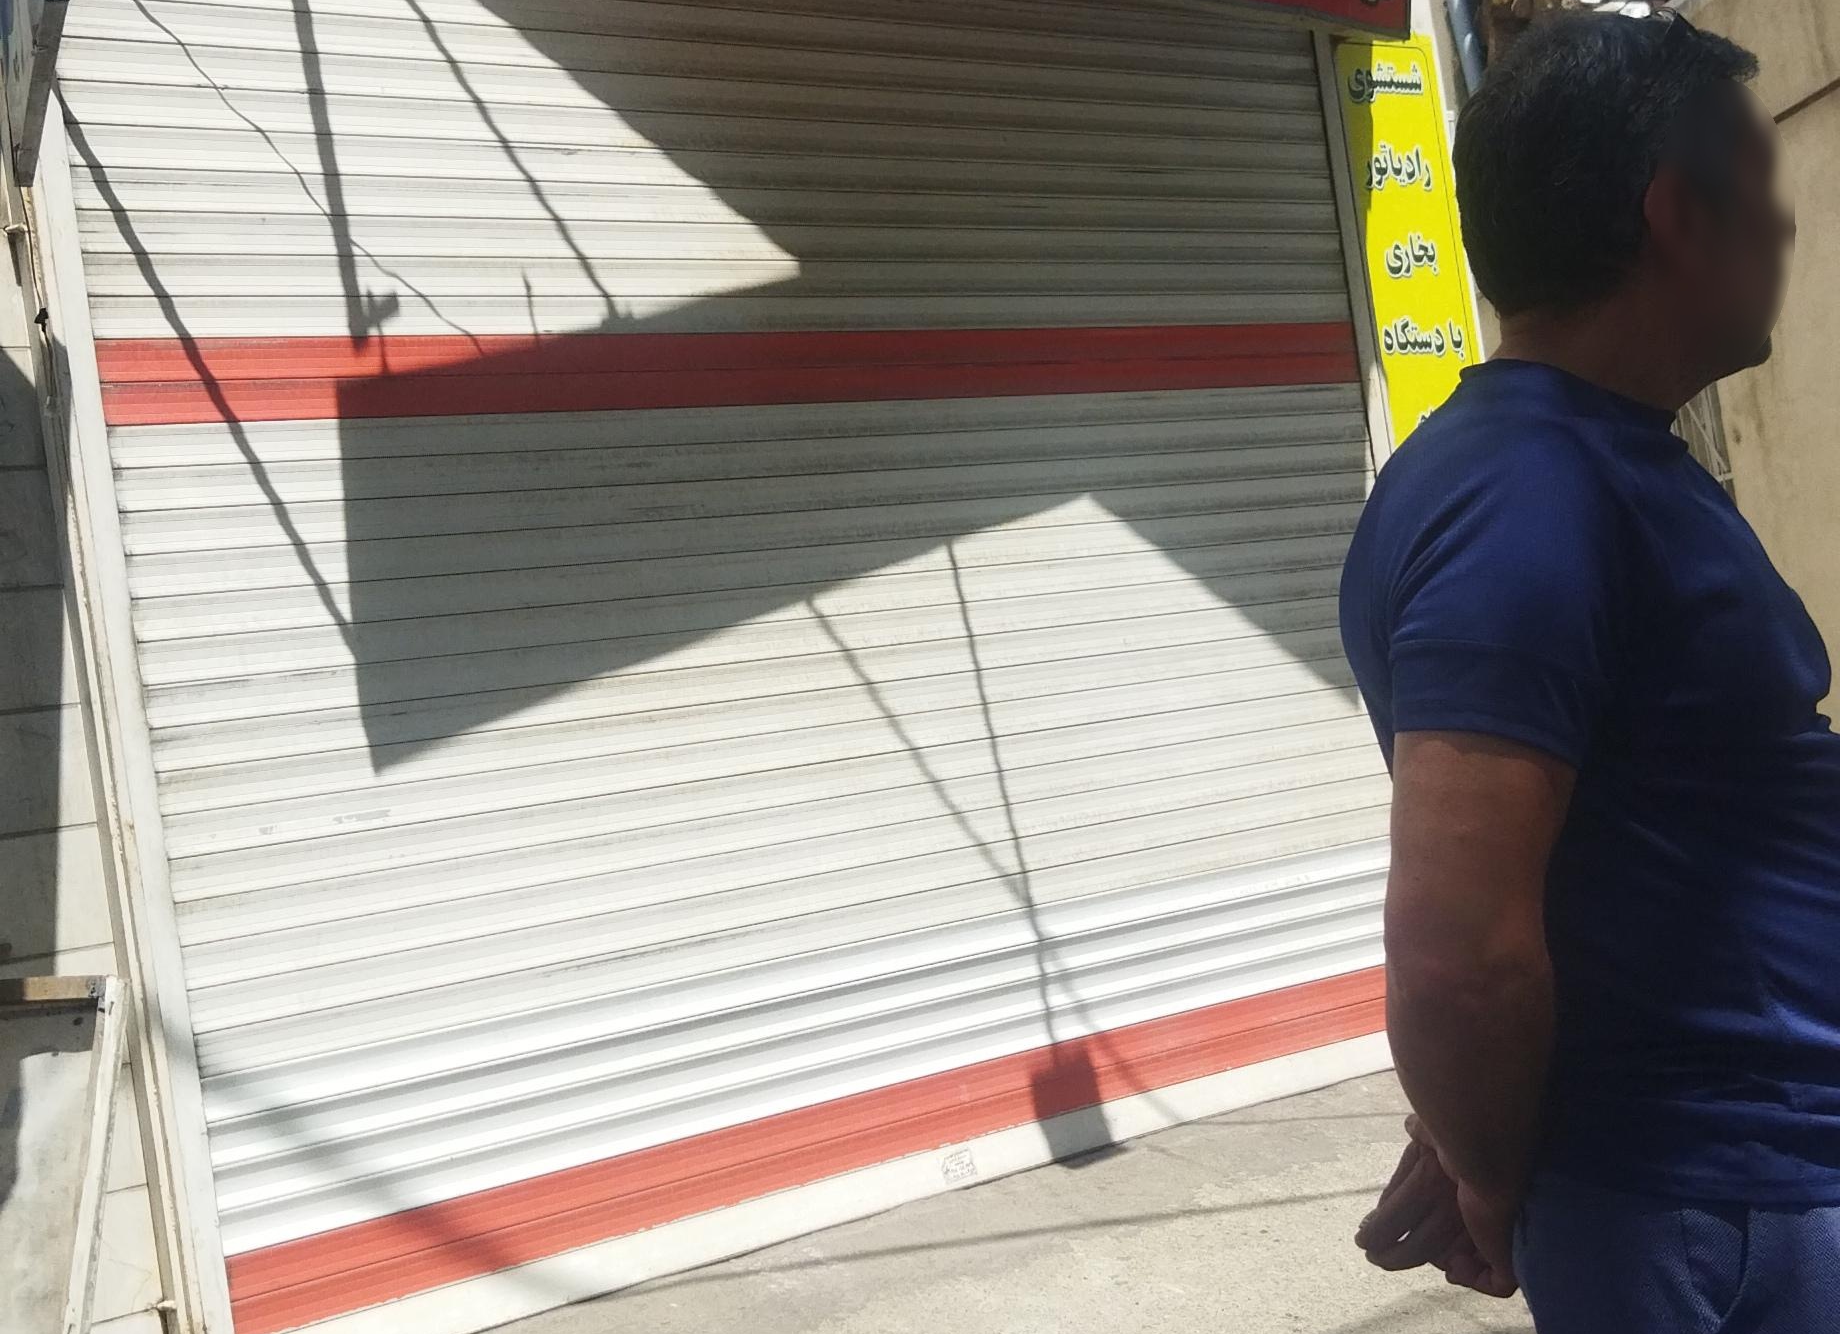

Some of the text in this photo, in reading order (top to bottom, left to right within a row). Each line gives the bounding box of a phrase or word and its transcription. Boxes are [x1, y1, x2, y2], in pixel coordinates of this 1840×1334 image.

[1347, 64, 1423, 103] شستشوی
[1364, 143, 1432, 189] رادیاتور
[1385, 235, 1438, 278] بخاری
[1383, 315, 1464, 359] با دستگاه
